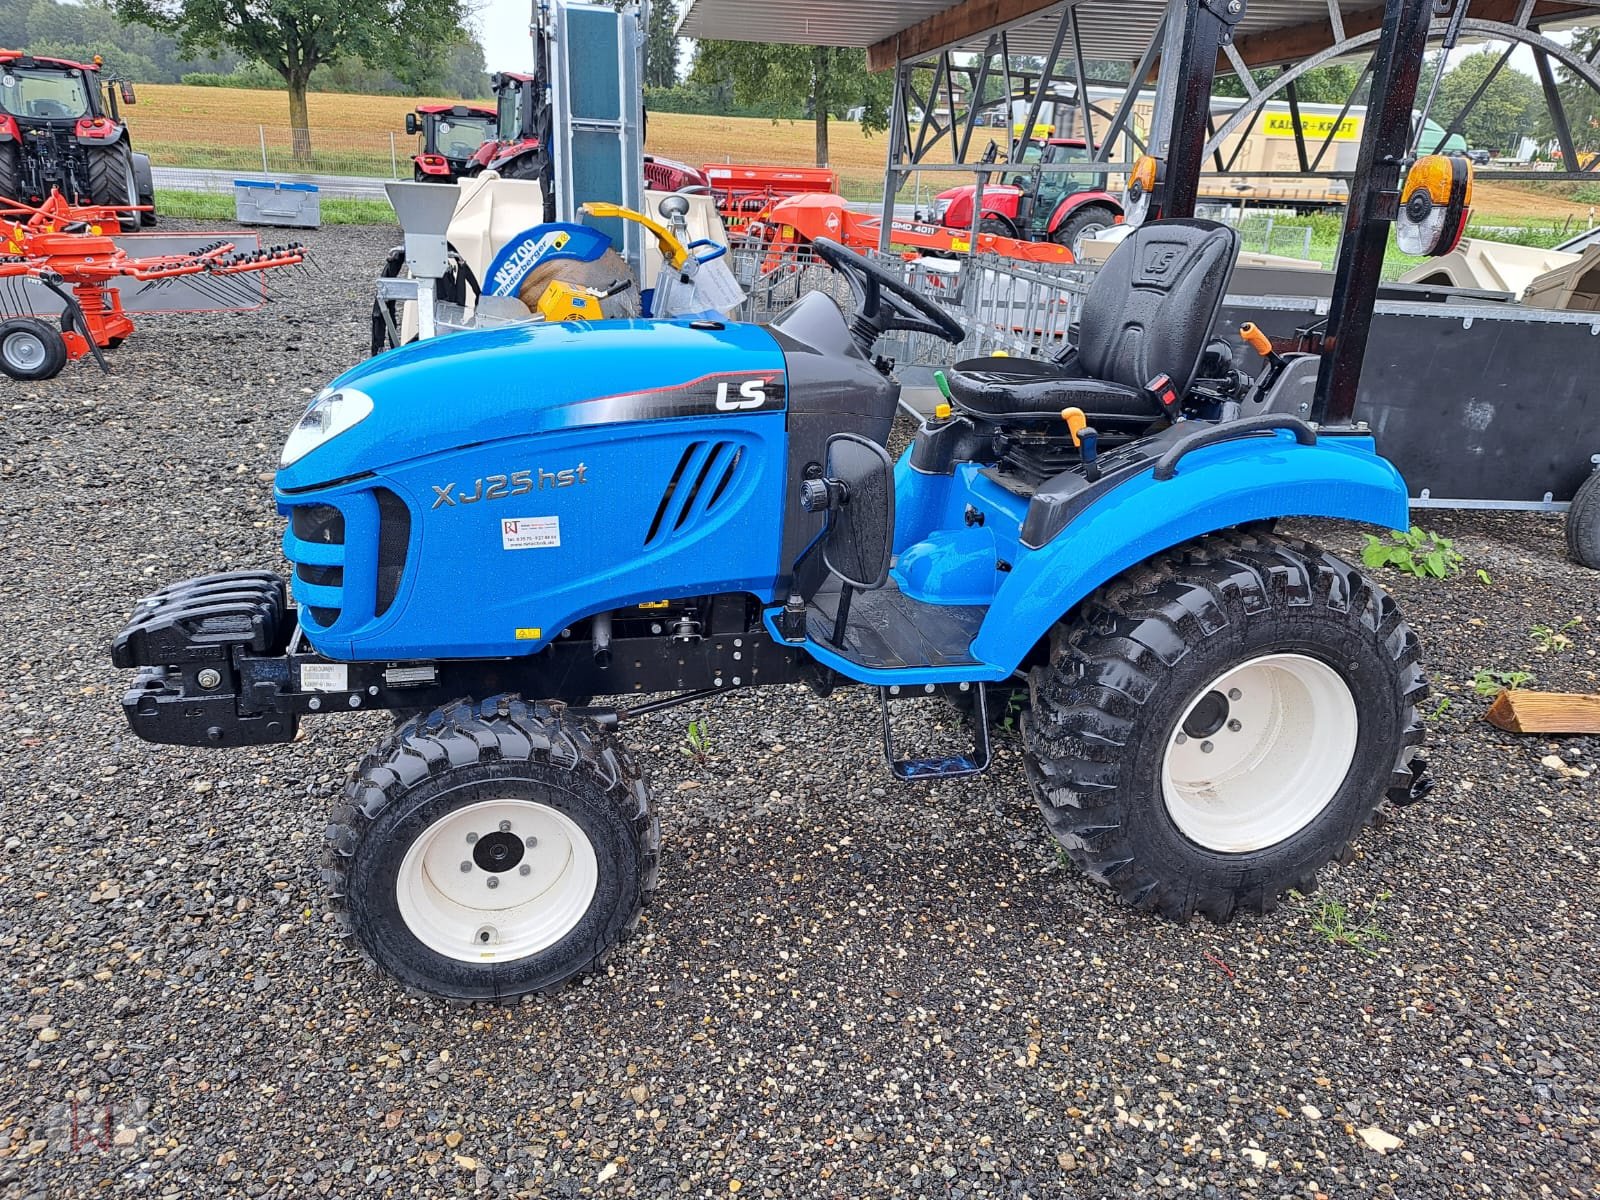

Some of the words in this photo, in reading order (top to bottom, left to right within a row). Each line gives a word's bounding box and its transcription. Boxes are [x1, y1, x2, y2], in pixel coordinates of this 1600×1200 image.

[891, 222, 912, 230] GMD
[914, 226, 934, 234] 4011
[494, 239, 536, 285] WS700
[496, 240, 547, 296] Binderberger
[716, 380, 766, 410] LS
